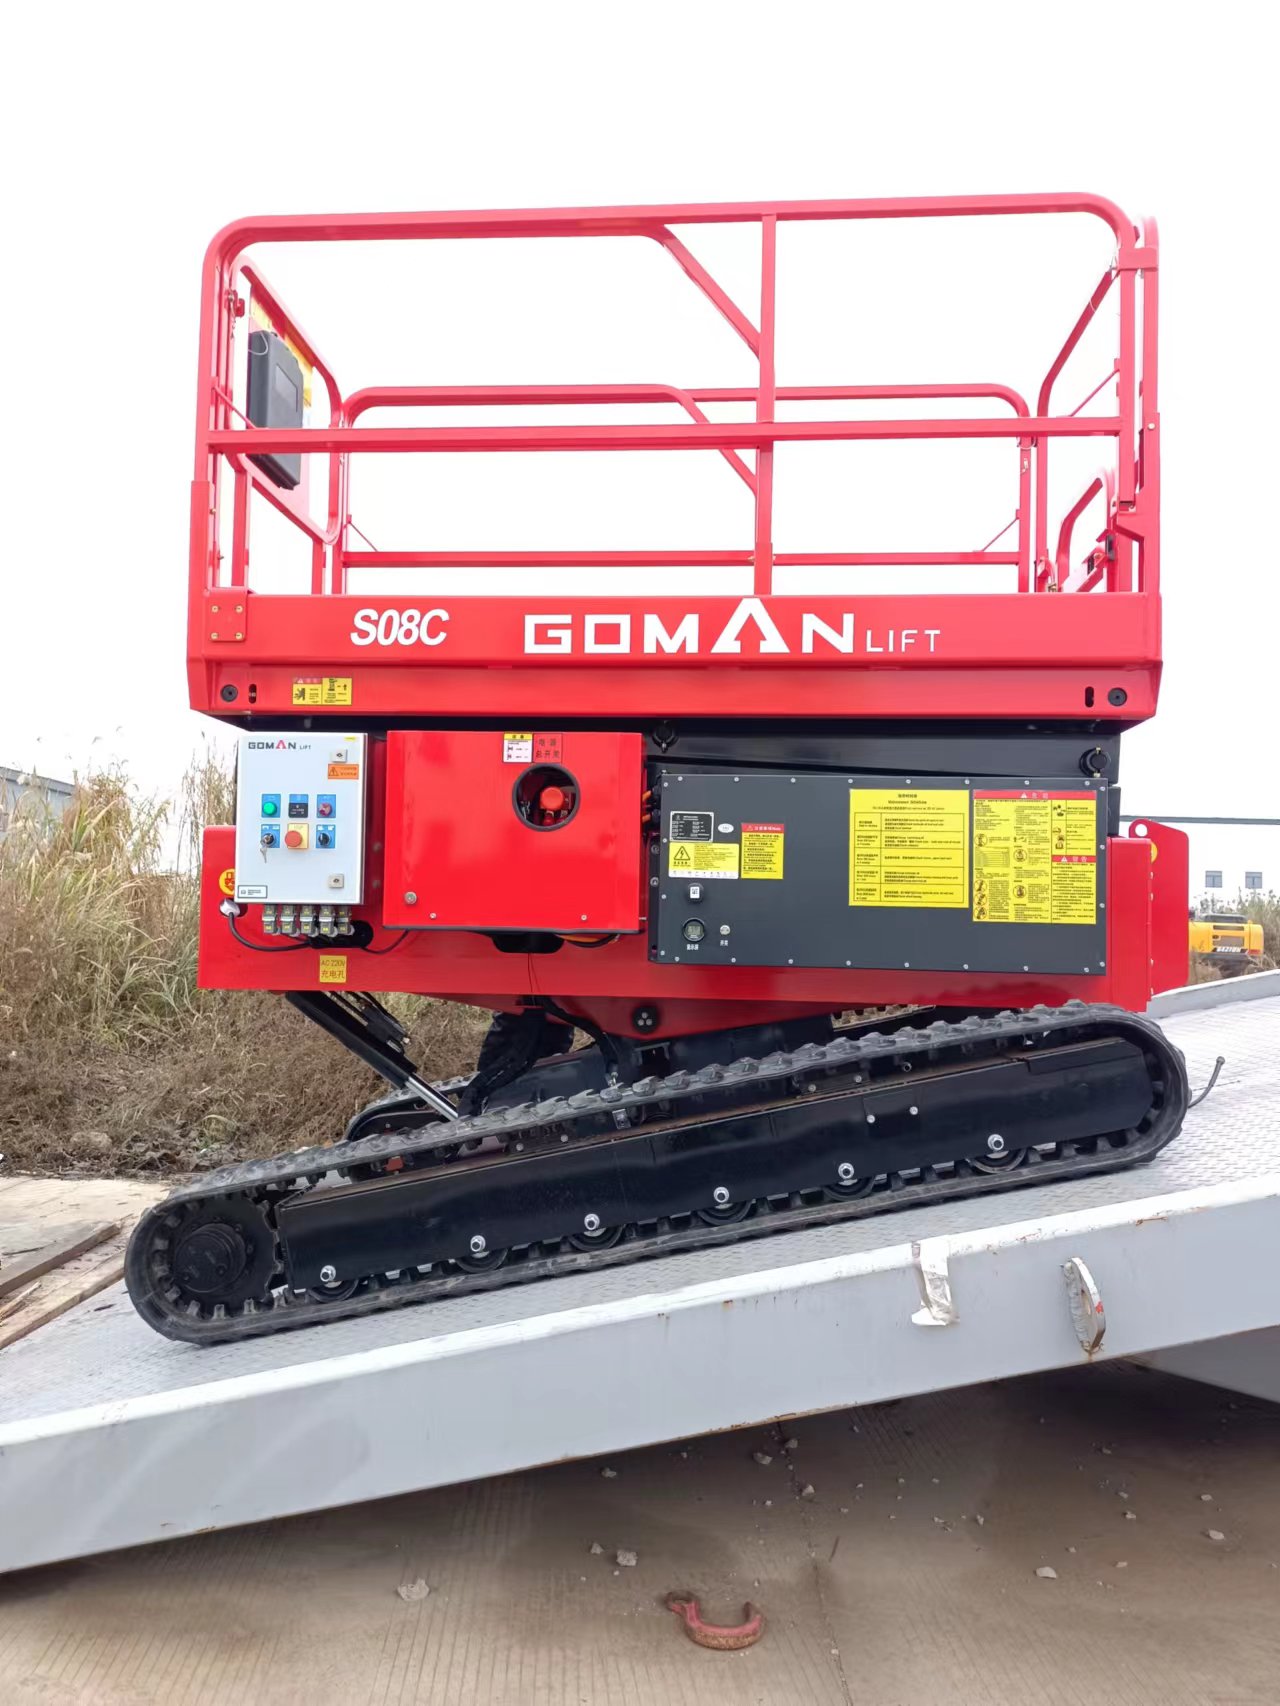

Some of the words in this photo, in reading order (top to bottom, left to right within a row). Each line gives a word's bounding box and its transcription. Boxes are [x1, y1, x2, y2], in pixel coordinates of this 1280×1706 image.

[350, 608, 450, 646] S08C
[523, 597, 855, 654] GOMAN
[865, 629, 941, 653] LIFT
[248, 740, 297, 750] GOMAN
